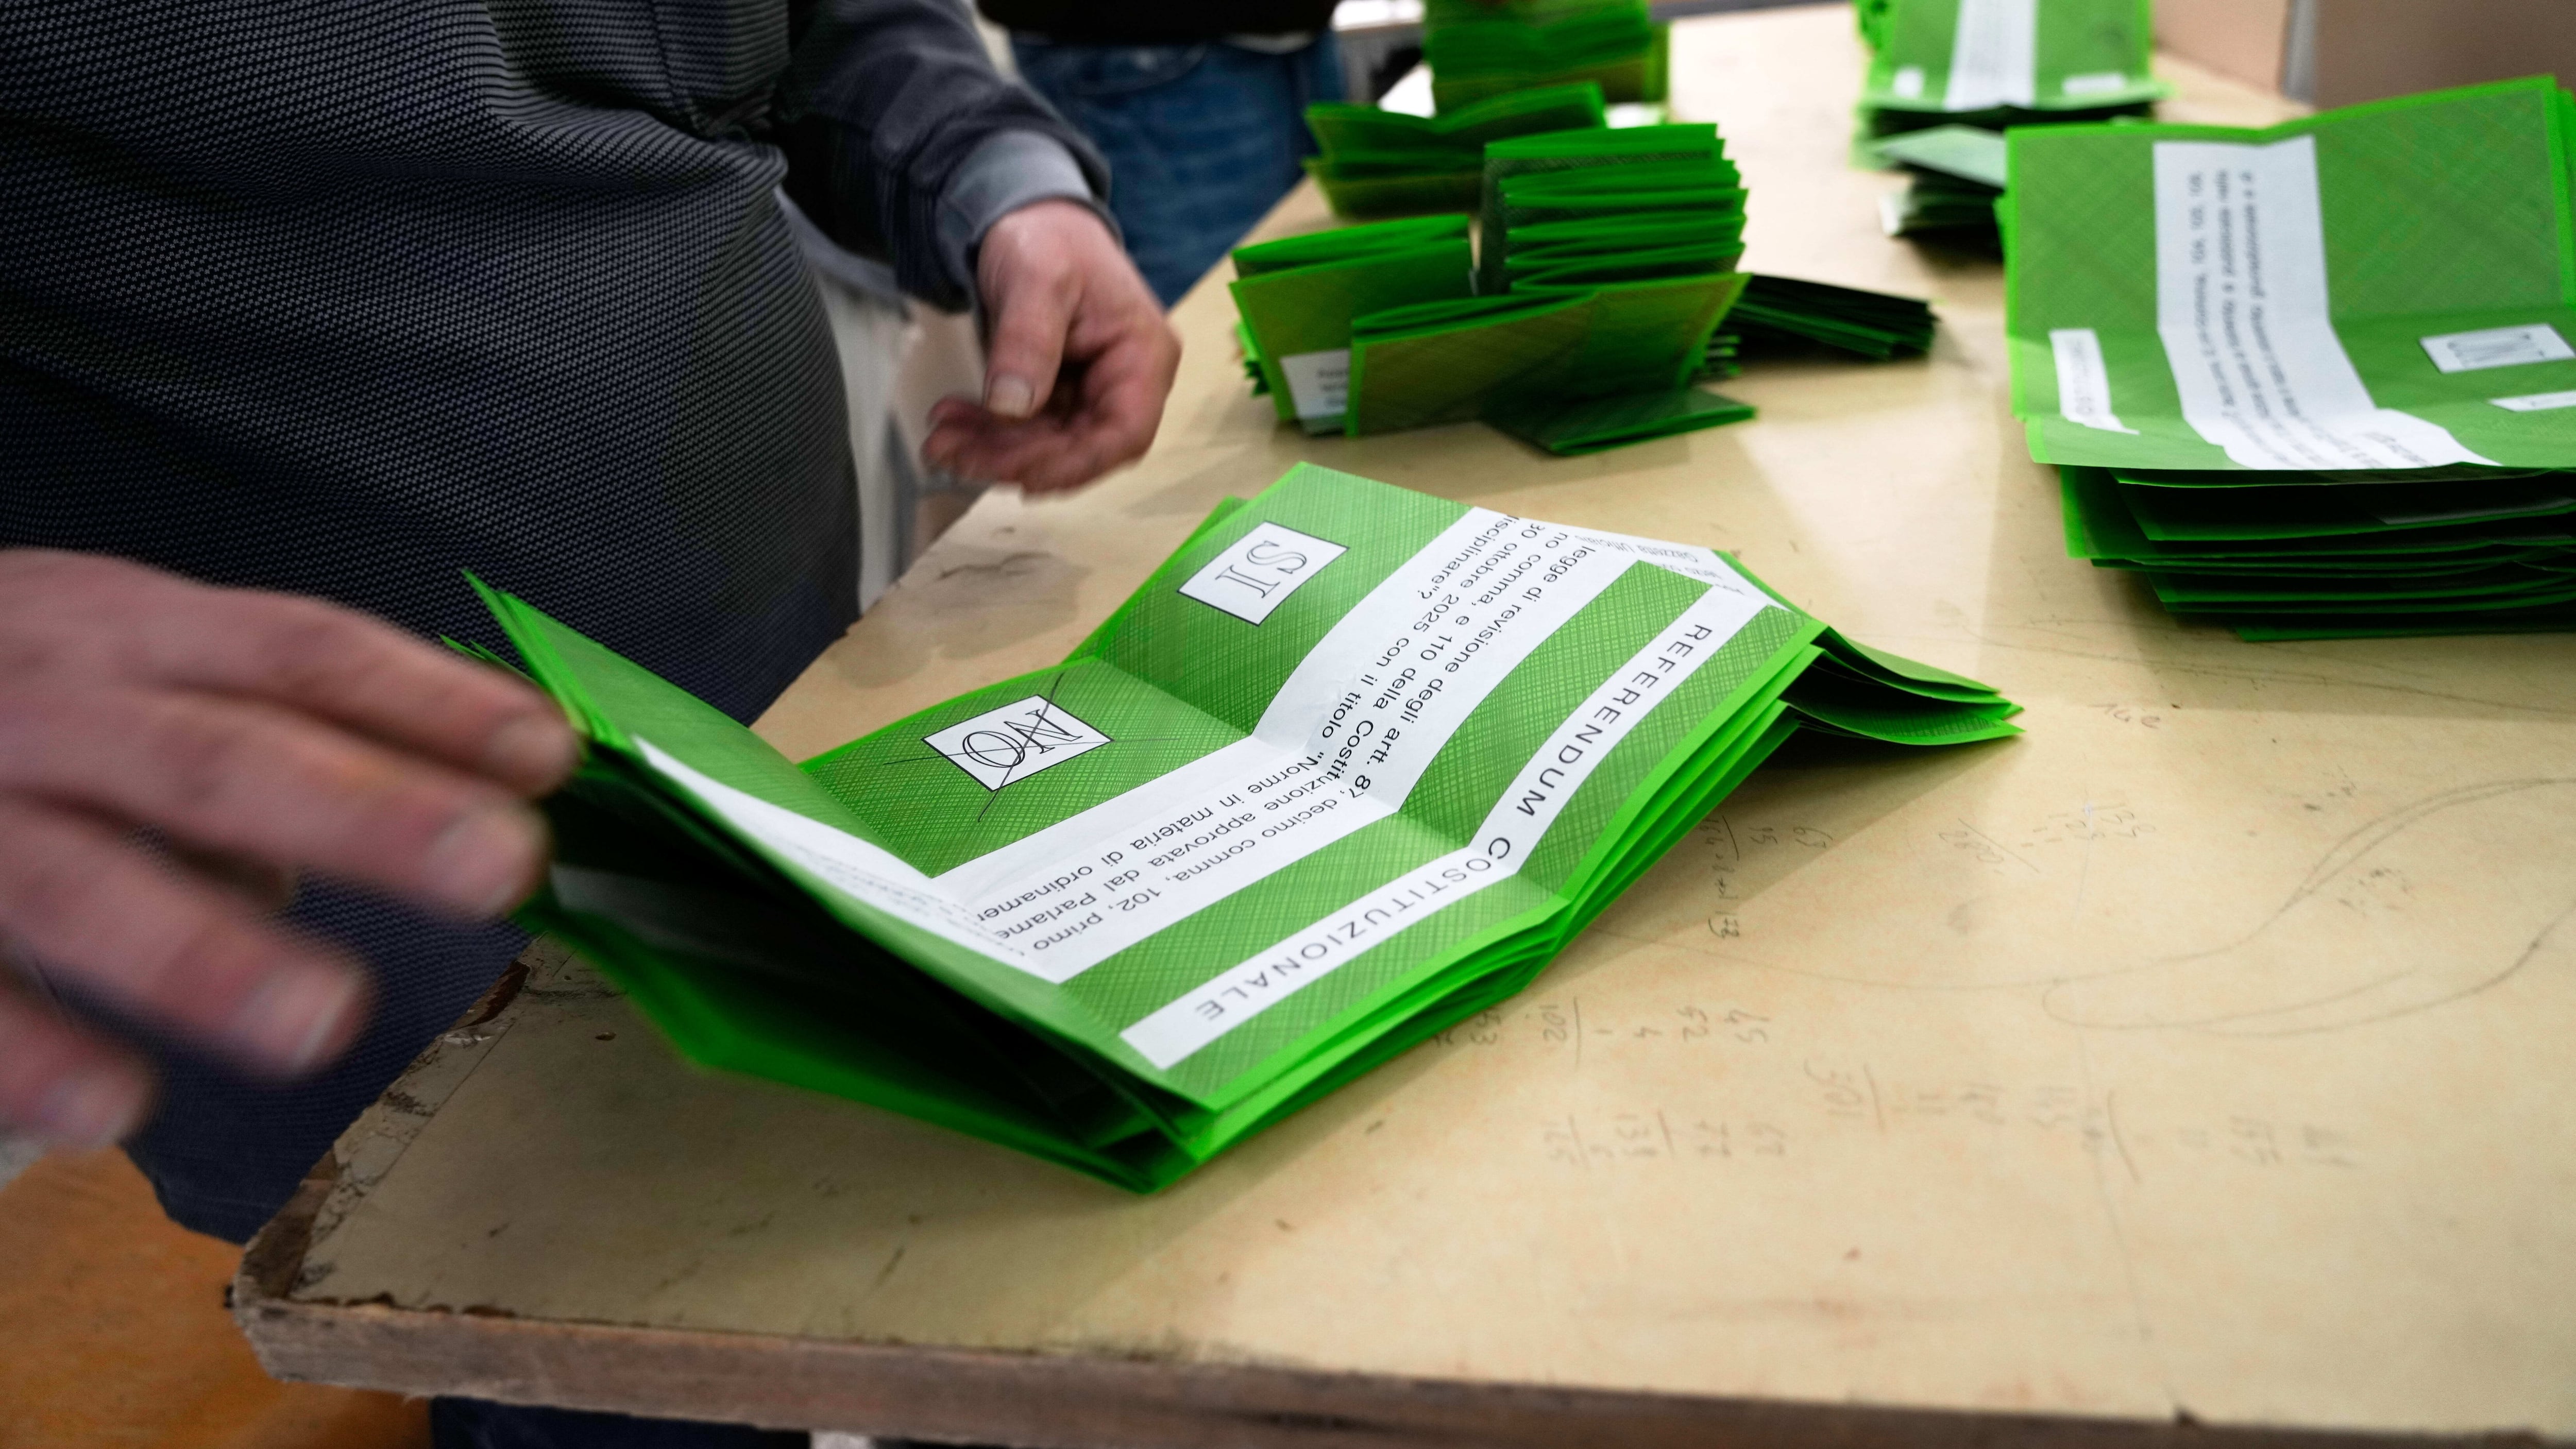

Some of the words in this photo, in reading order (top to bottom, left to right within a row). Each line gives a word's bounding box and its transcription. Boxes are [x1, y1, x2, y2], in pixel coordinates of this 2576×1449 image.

[1214, 540, 1307, 599] SI
[1460, 543, 1517, 588] ottobre
[1471, 554, 1541, 606] comma,
[1543, 545, 1596, 583] legge
[1413, 593, 1460, 633] 2025
[1522, 587, 1542, 602] di
[1445, 604, 1522, 673] revisione
[1455, 616, 1470, 625] e
[1376, 638, 1410, 667] con
[1420, 635, 1453, 661] 110
[1360, 674, 1378, 686] il
[1372, 668, 1416, 709] della
[1322, 692, 1362, 739] titolo
[1400, 678, 1443, 724] degli
[1516, 624, 1713, 816] REFERENDUM
[962, 709, 1083, 768] NO
[1366, 727, 1400, 765] artt.
[1247, 751, 1325, 794] "Norme
[1264, 720, 1374, 811] Costituzione
[1218, 793, 1245, 807] in
[1340, 774, 1371, 799] 87,
[1129, 807, 1214, 850] materia
[1261, 799, 1337, 838] decimo
[1100, 851, 1124, 867] di
[1147, 813, 1256, 867] approvata
[1165, 839, 1256, 881] comma,
[1103, 870, 1140, 892] dal
[1108, 888, 1161, 911] 102,
[1033, 912, 1104, 950] primo
[1194, 837, 1511, 1020] COSTITUZIONALE
